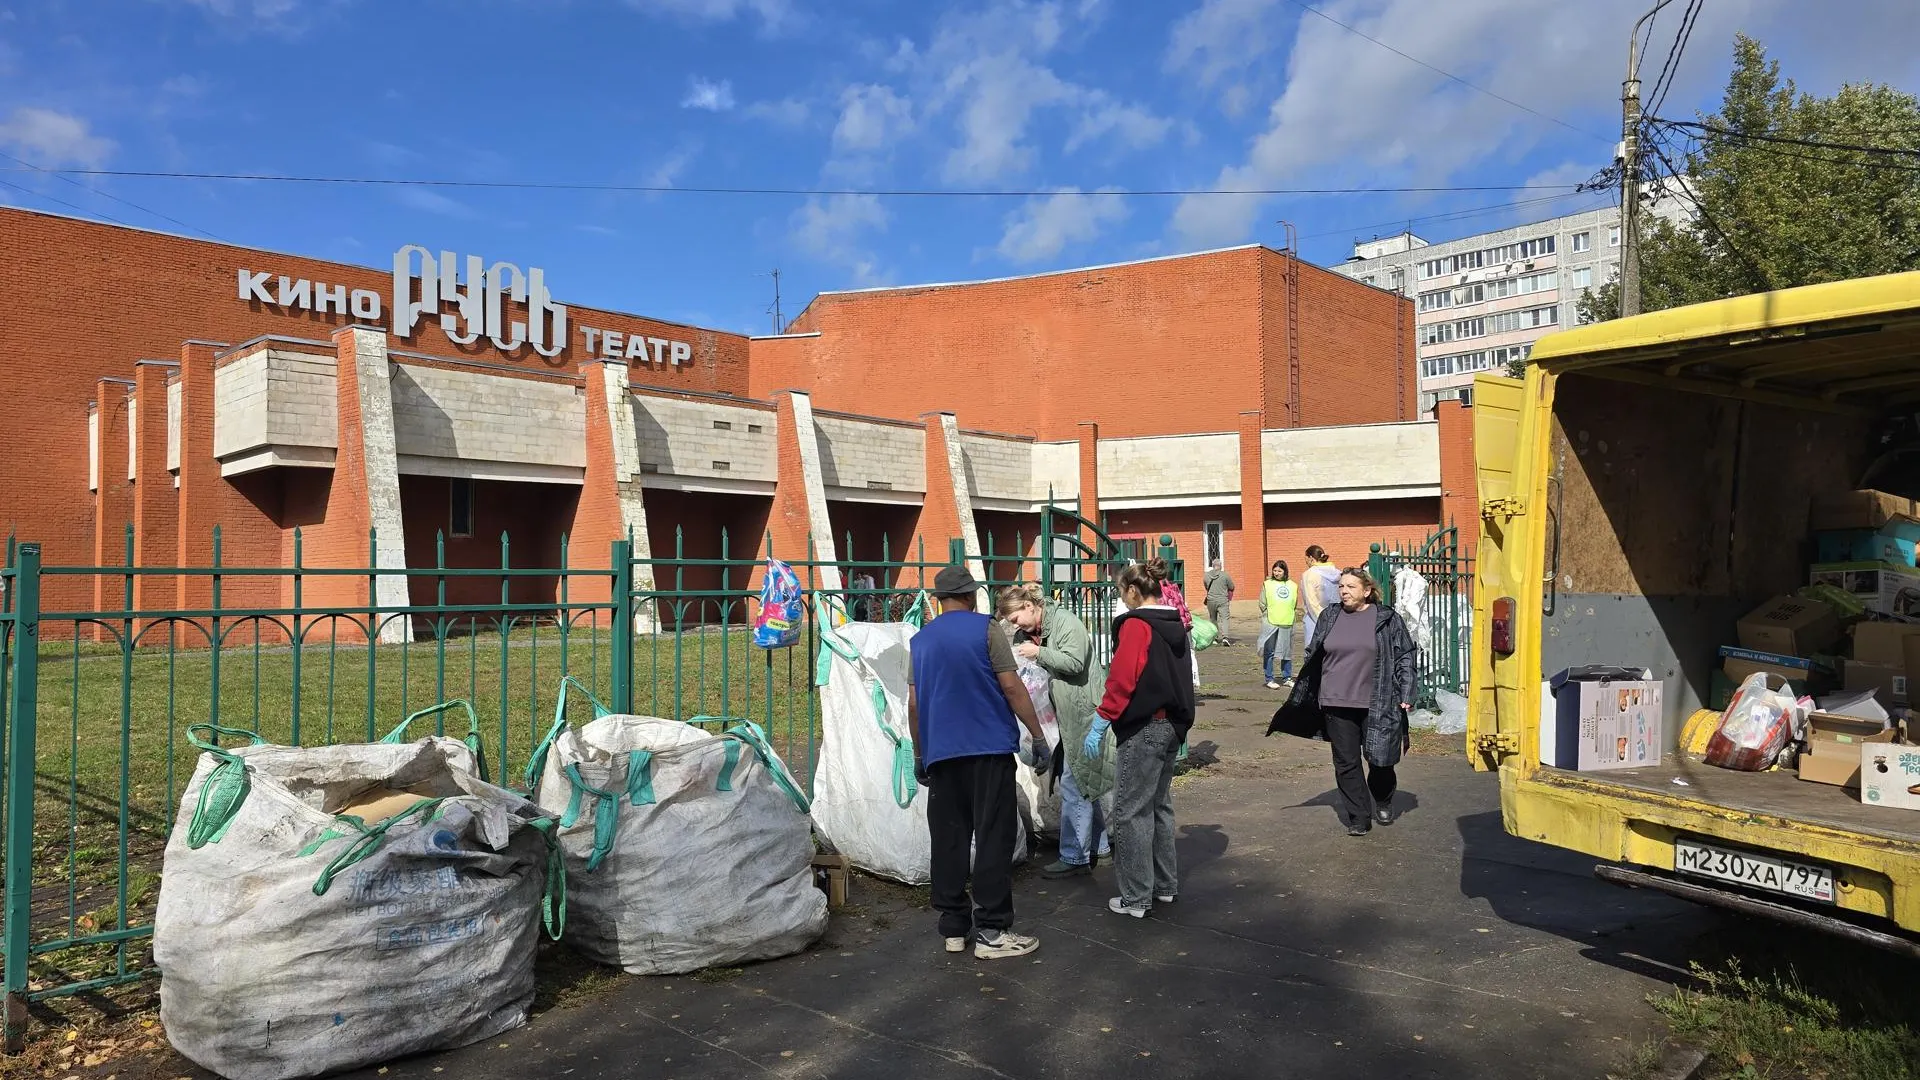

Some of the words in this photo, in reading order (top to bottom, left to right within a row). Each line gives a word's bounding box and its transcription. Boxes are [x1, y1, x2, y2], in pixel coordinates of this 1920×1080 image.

[238, 269, 381, 320] КИНО
[393, 244, 567, 357] РУСЬ
[580, 325, 692, 366] ТЕАТР
[1682, 847, 1778, 886] М230ХА
[1783, 863, 1824, 888] 797
[1794, 884, 1815, 895] RUS
[345, 906, 371, 919] PET
